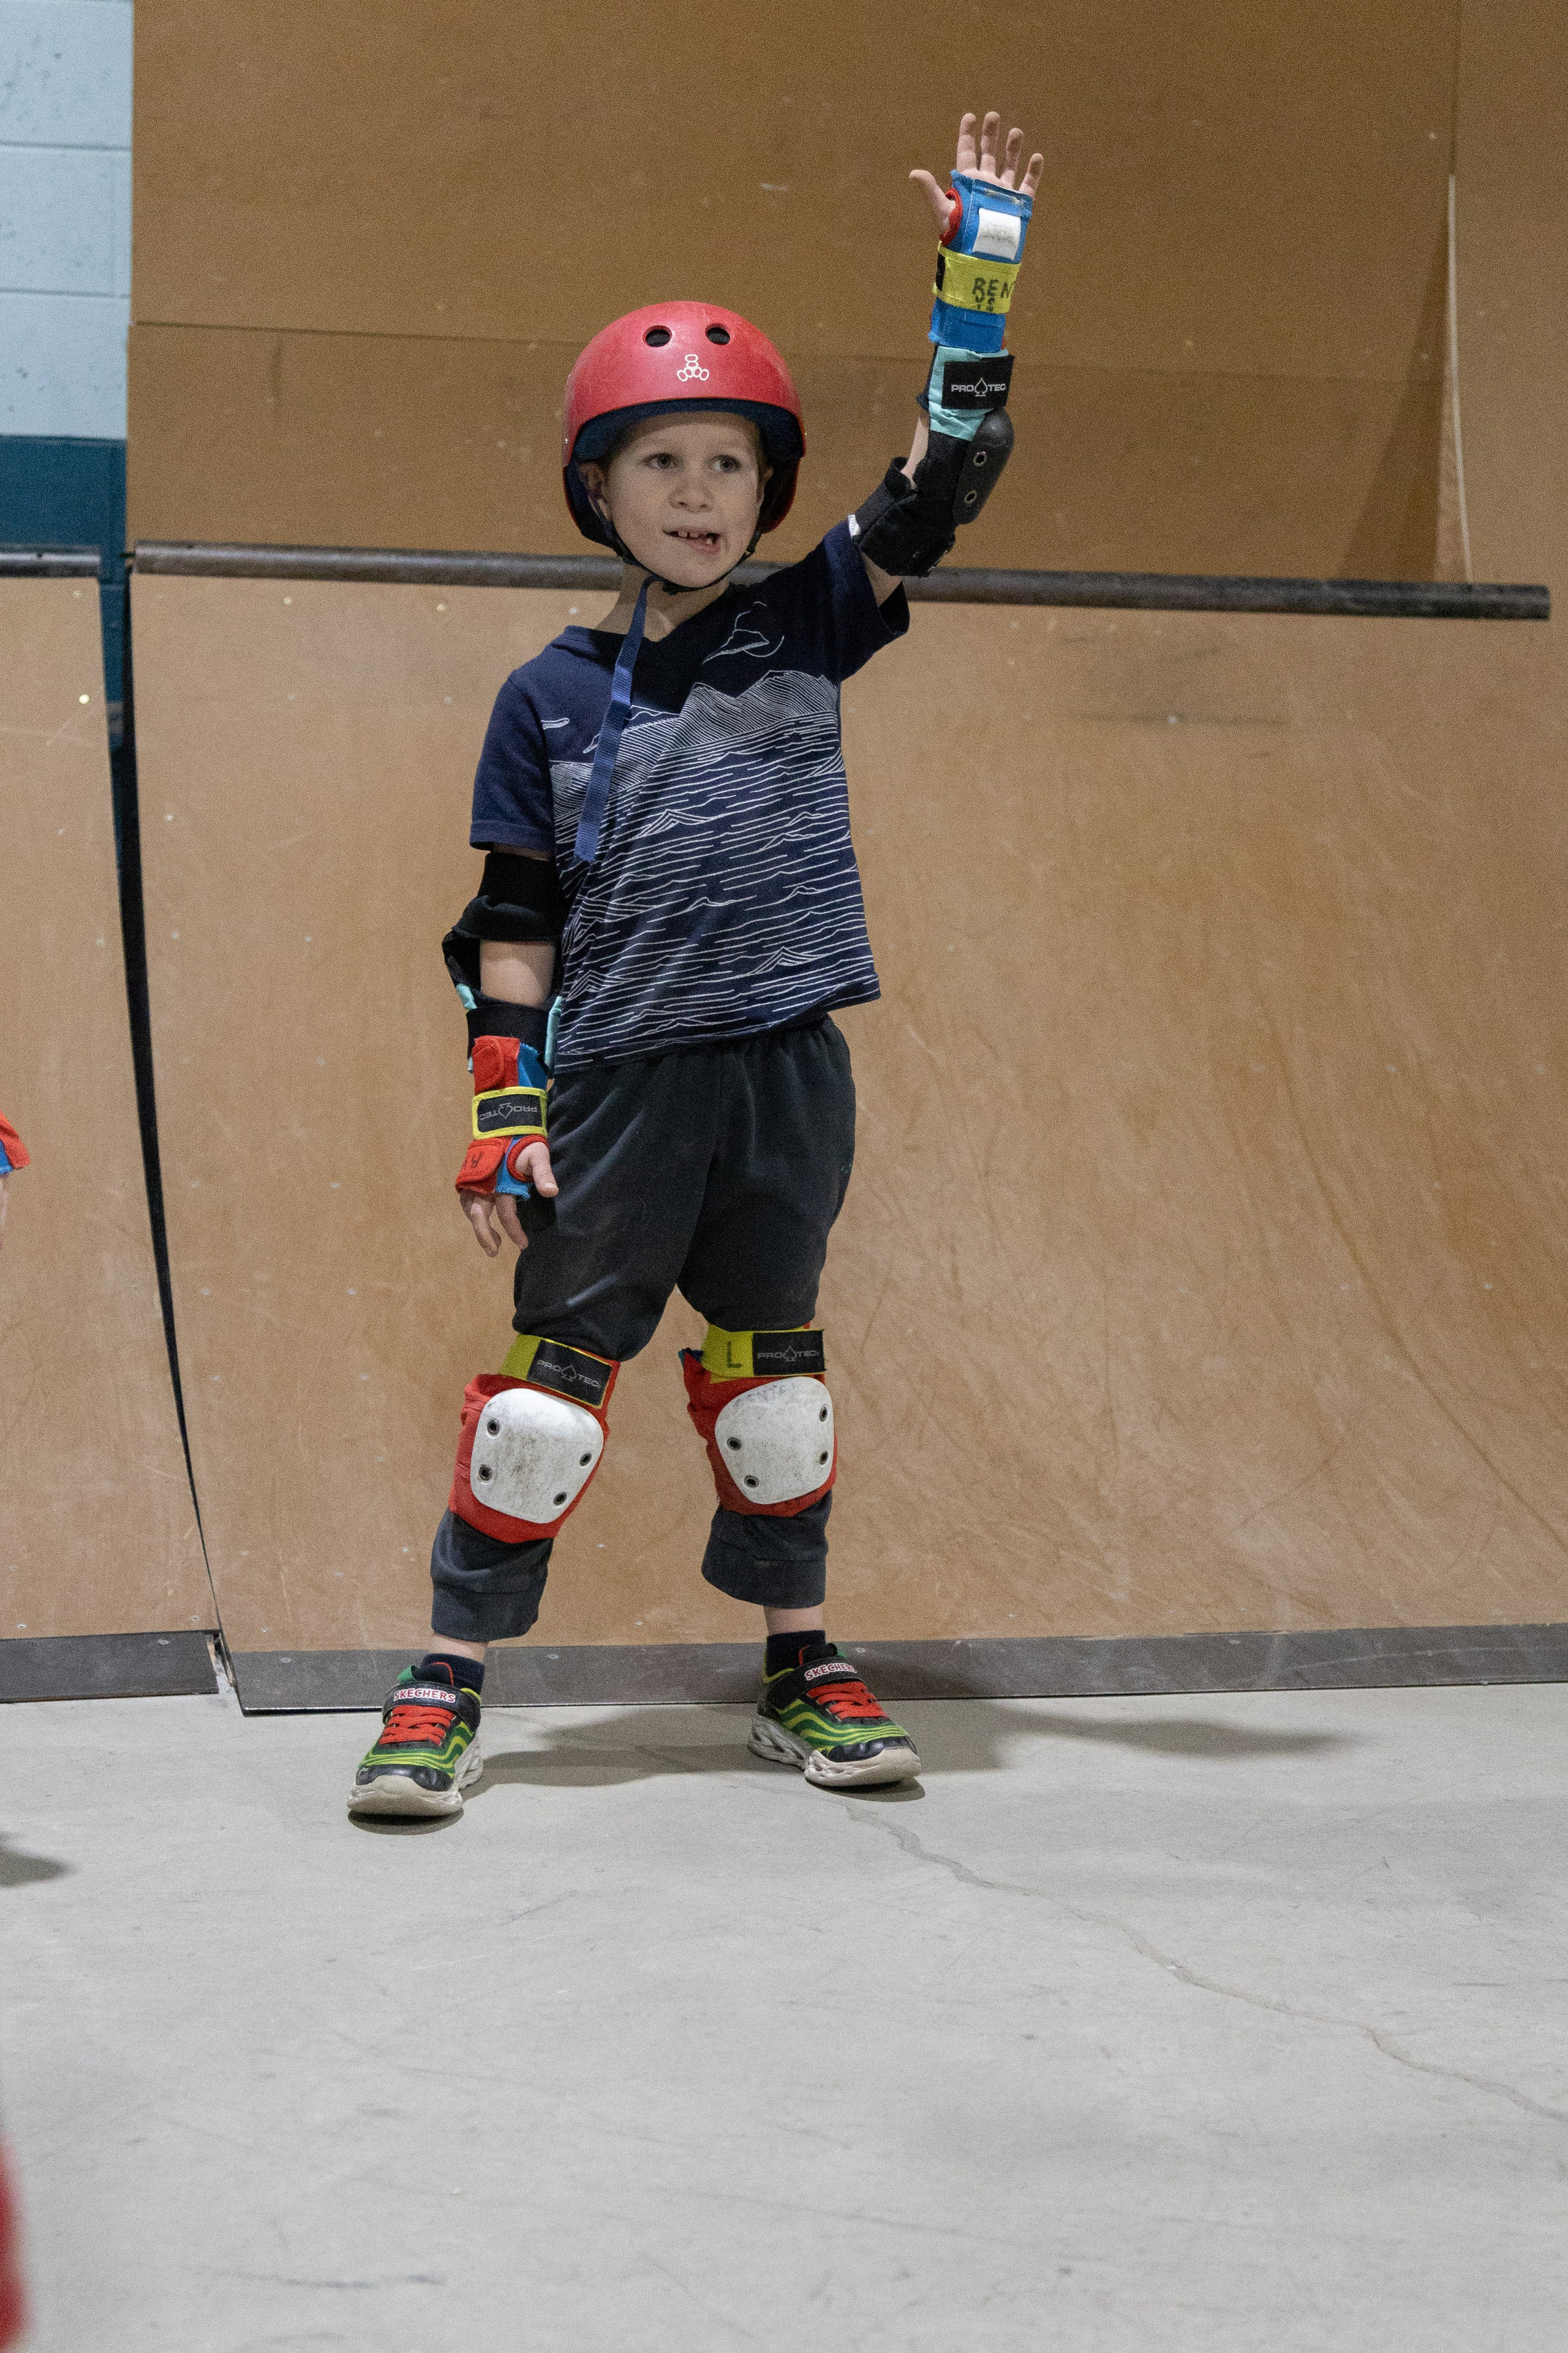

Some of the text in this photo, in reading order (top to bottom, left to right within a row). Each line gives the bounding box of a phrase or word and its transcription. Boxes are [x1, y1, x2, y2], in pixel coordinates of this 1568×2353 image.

[726, 1340, 742, 1369] L
[804, 1663, 858, 1681] SKECHERS
[393, 1688, 456, 1703] SKECHERS
